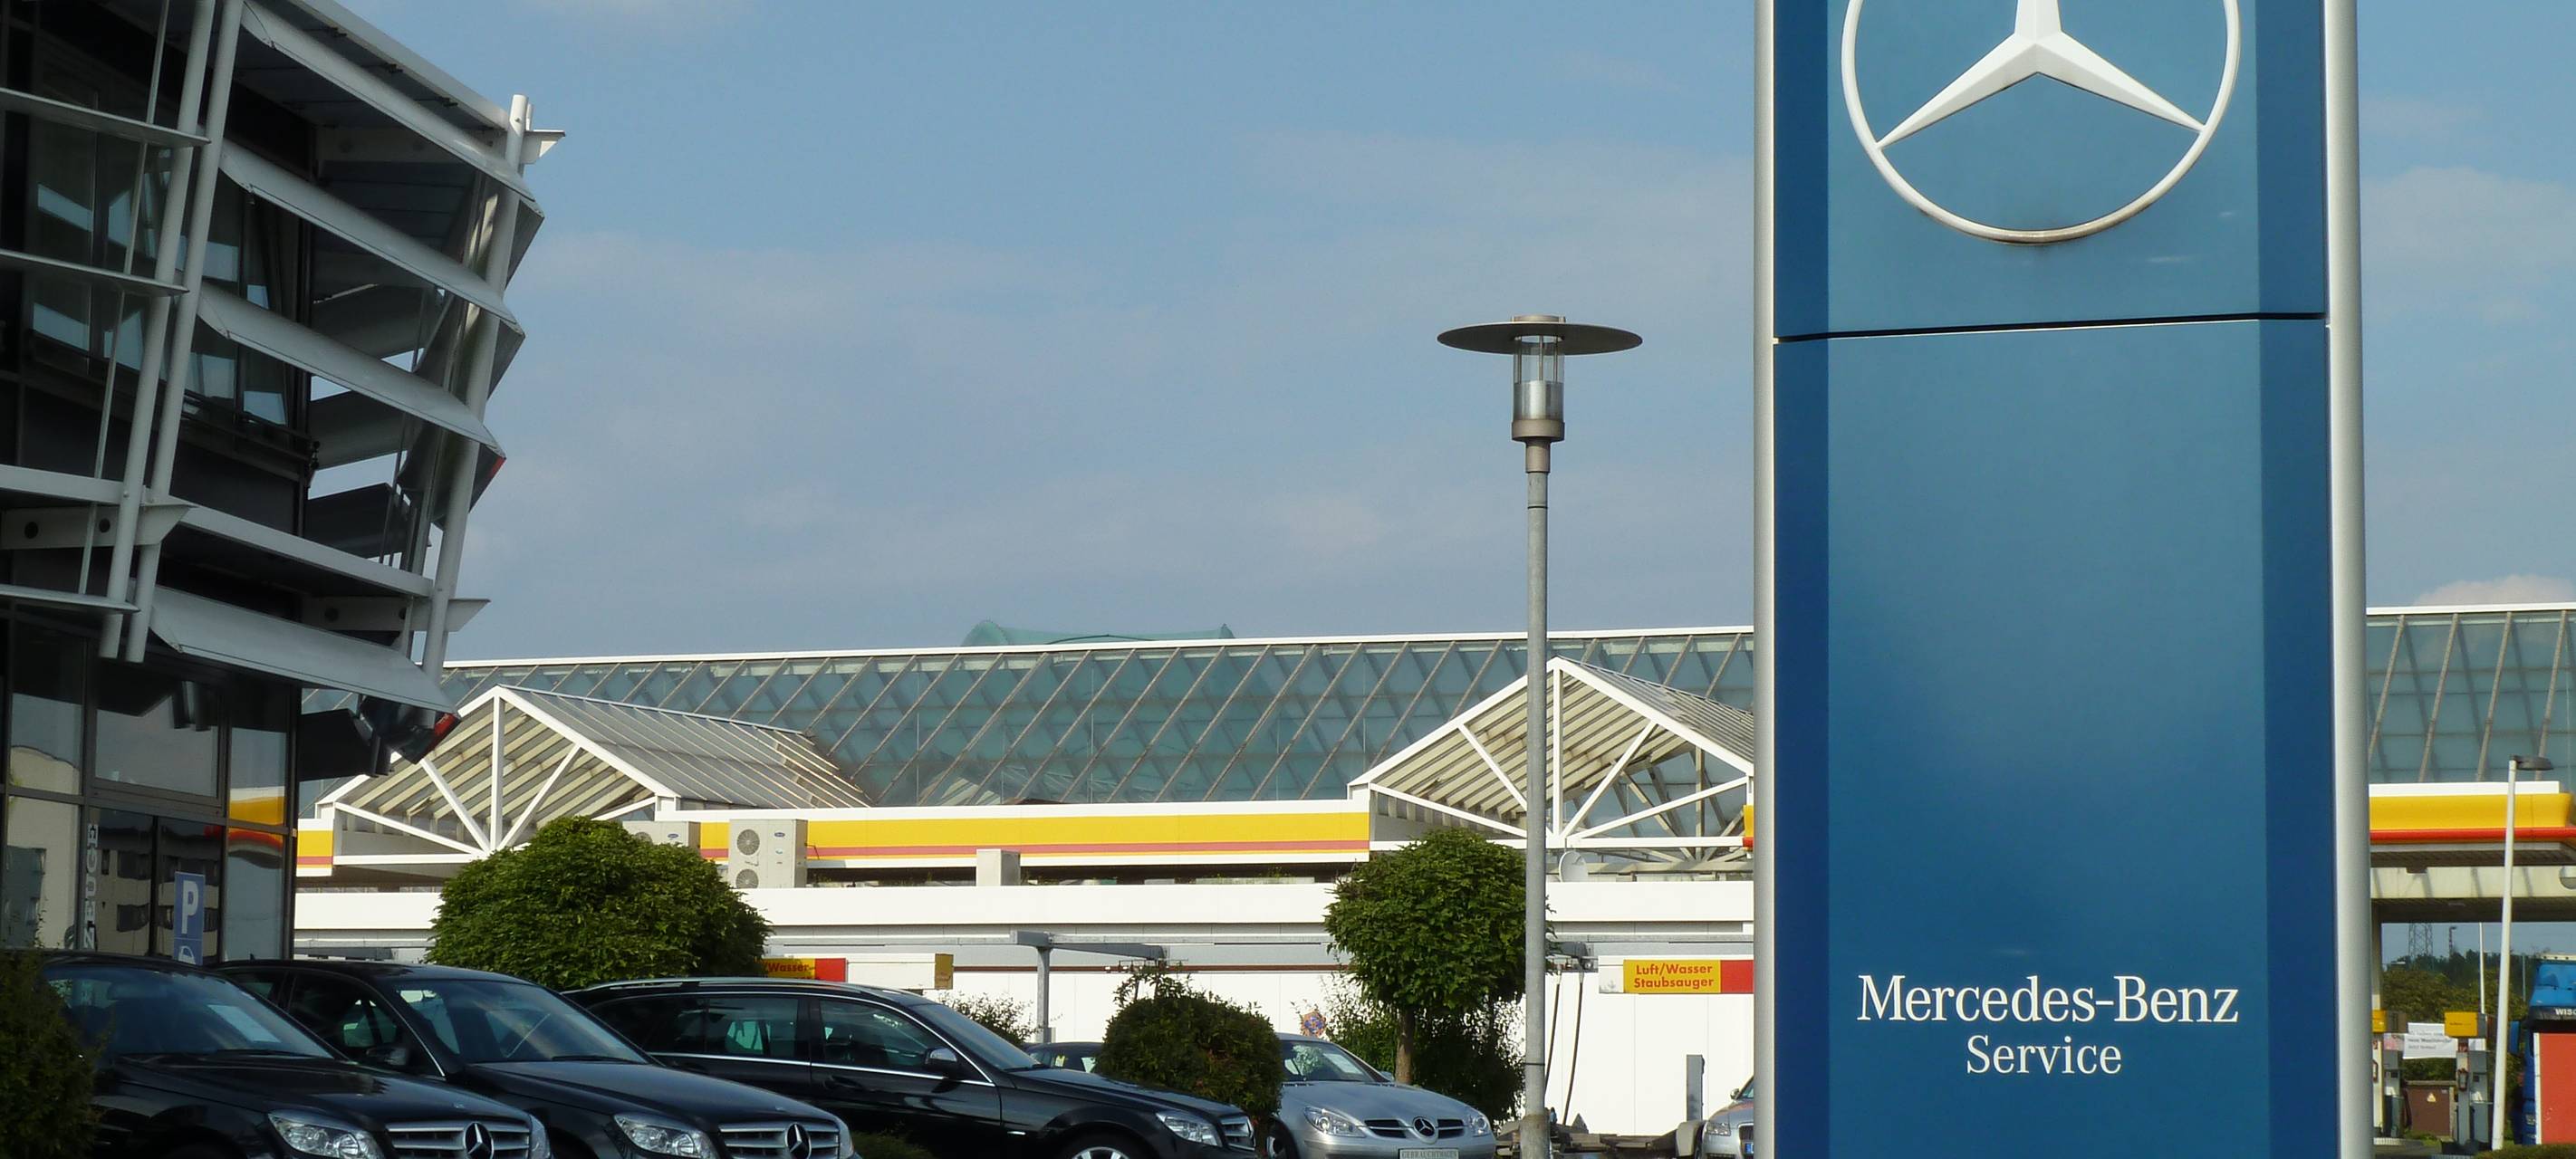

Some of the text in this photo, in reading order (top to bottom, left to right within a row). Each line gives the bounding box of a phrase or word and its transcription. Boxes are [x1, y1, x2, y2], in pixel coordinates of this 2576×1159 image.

[181, 880, 198, 934] P
[1634, 976, 1715, 990] Staubsauger
[1636, 963, 1713, 975] Luft/Wasser
[1857, 974, 2239, 1023] Mercedes-Benz
[1966, 1034, 2122, 1075] Service
